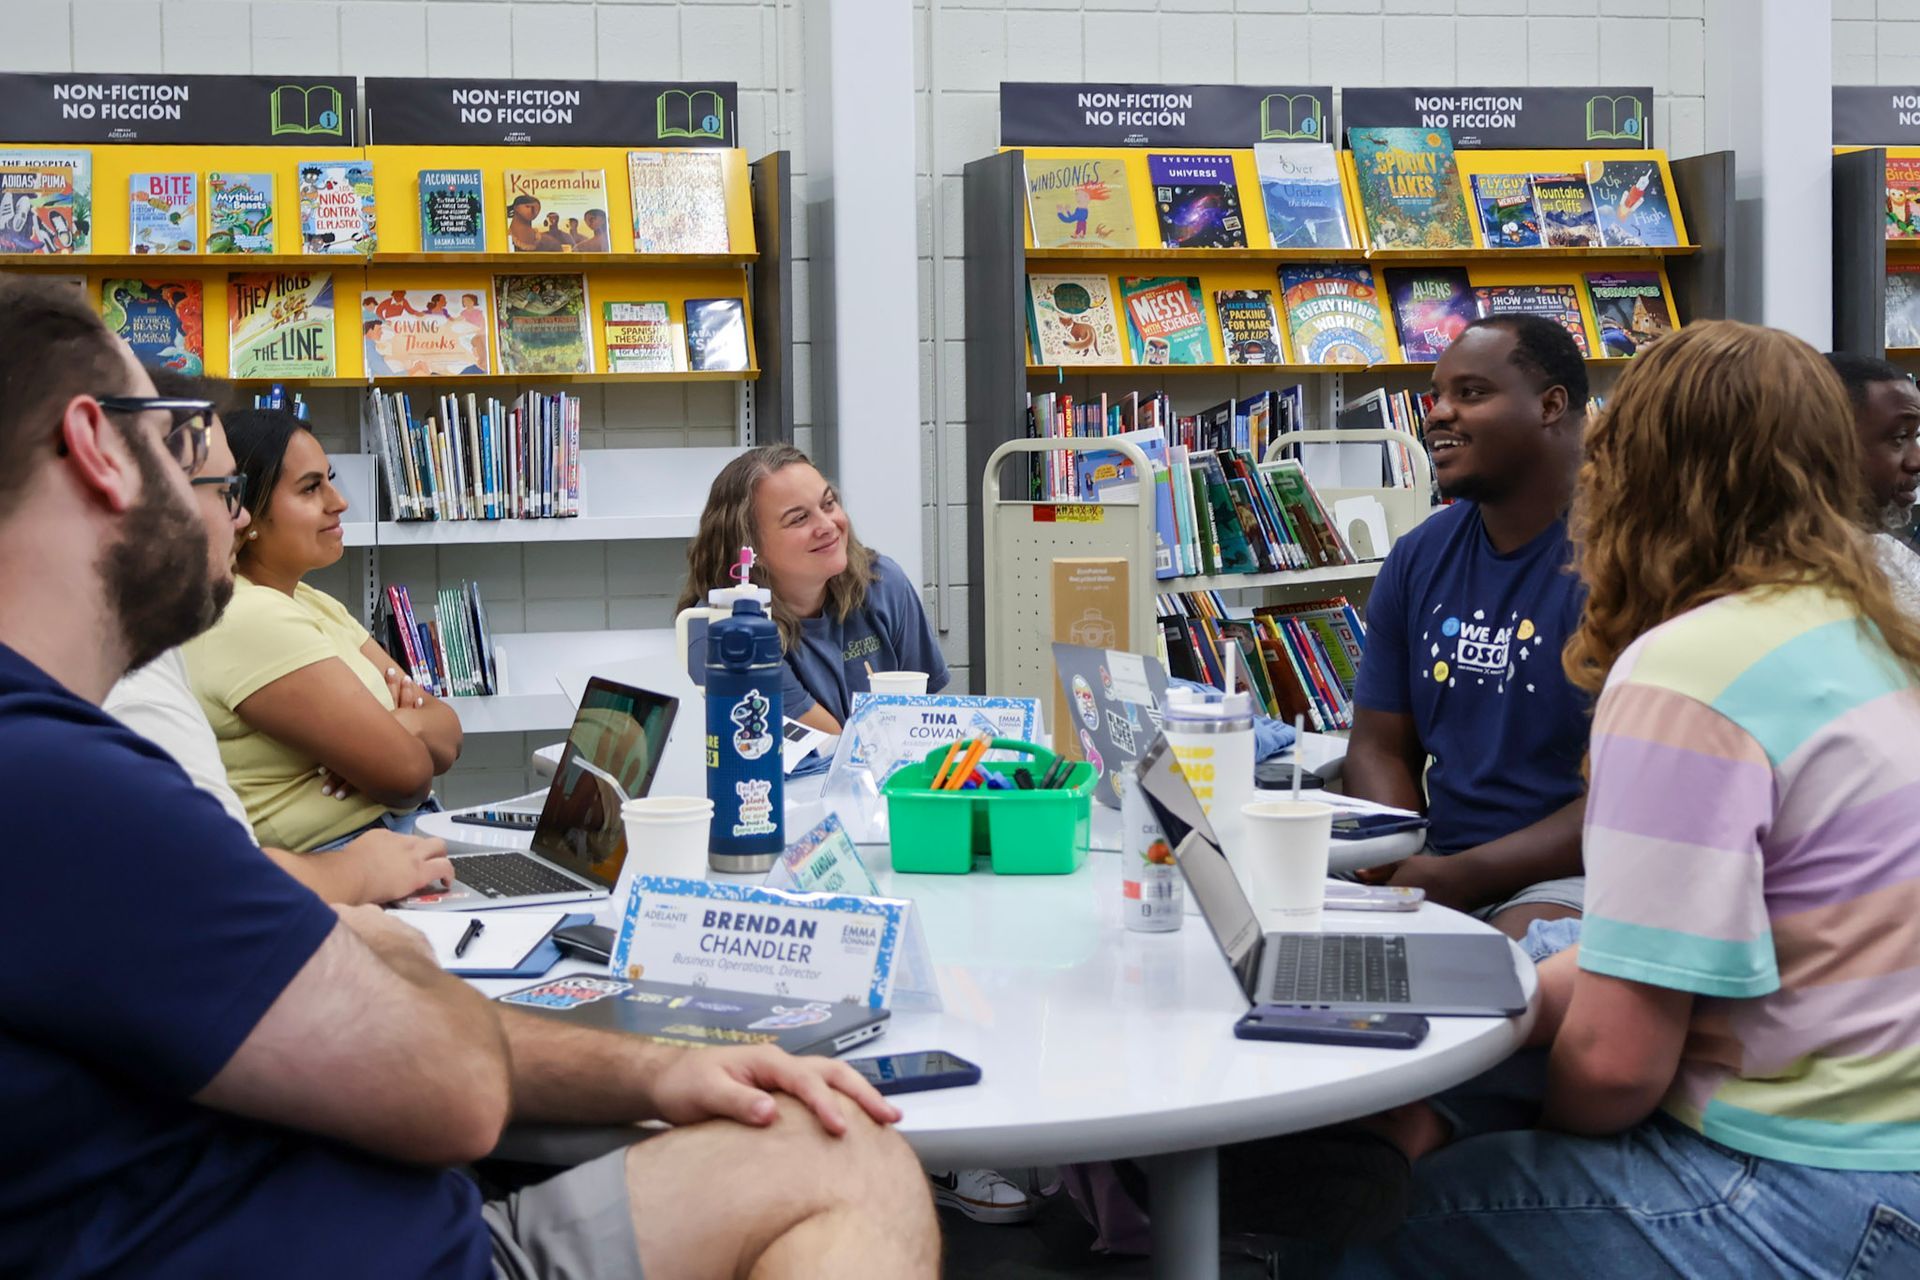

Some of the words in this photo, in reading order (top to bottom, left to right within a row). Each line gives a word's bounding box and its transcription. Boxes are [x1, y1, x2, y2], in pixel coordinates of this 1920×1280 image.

[53, 84, 189, 101] NON-FICTION
[452, 89, 580, 106] NON-FICTION
[1078, 93, 1193, 109] NON-FICTION
[1415, 96, 1523, 111] NON-FICTION
[62, 103, 96, 119] NO
[101, 99, 181, 120] FICCIÓN
[461, 108, 493, 124] NO
[497, 105, 573, 124] FICCIÓN
[1085, 111, 1114, 126] NO
[1118, 108, 1186, 126] FICCIÓN
[1422, 114, 1449, 128] NO
[1452, 110, 1516, 129] FICCIÓN
[25, 160, 78, 168] HOSPITAL
[1162, 156, 1230, 164] EYEWITNESS
[1375, 151, 1437, 175] SPOOKY
[1, 174, 34, 188] ADIDAS
[41, 174, 66, 188] PUMA
[425, 173, 479, 186] ACCOUNTABLE
[1030, 161, 1101, 193] WINDSONGS
[1169, 169, 1217, 178] UNIVERSE
[510, 172, 601, 197] Kapaemahu
[1387, 175, 1437, 199] LAKES
[1479, 177, 1500, 189] FLY
[1502, 177, 1527, 190] GUY
[217, 191, 264, 203] Mythical
[1534, 185, 1585, 200] Mountains
[1600, 188, 1618, 205] Up
[233, 201, 267, 210] Beasts
[318, 206, 357, 218] CONTRA
[1555, 199, 1582, 213] Cliffs
[1633, 207, 1667, 226] High
[1315, 281, 1349, 296] HOW
[1412, 280, 1453, 299] ALIENS
[1592, 285, 1660, 298] TORNADOES
[233, 279, 274, 321] THEY
[275, 273, 312, 298] HOLD
[1492, 295, 1521, 306] SHOW
[1131, 289, 1190, 326] MESSY
[1229, 309, 1267, 320] PACKING
[1296, 298, 1377, 321] EVERYTHING
[132, 322, 171, 331] BEASTS
[393, 319, 440, 335] GIVING
[1161, 311, 1201, 333] SCIENCE!
[1228, 319, 1246, 331] FOR
[1246, 319, 1272, 330] MARS
[1312, 314, 1366, 332] WORKS
[620, 327, 660, 337] SPANISH
[1235, 331, 1250, 341] FOR
[1250, 330, 1270, 340] KIDS
[253, 342, 279, 361] THE
[281, 327, 325, 361] LINE
[404, 334, 457, 353] Thanks
[1065, 408, 1073, 421] HOW
[1460, 621, 1491, 643] WE
[921, 712, 958, 725] TINA
[909, 726, 967, 740] COWAN
[644, 910, 689, 923] ADELANTE
[702, 909, 818, 940] BRENDAN
[842, 924, 877, 938] EMMA
[700, 933, 812, 964] CHANDLER
[672, 952, 715, 968] Business
[778, 964, 823, 980] Director
